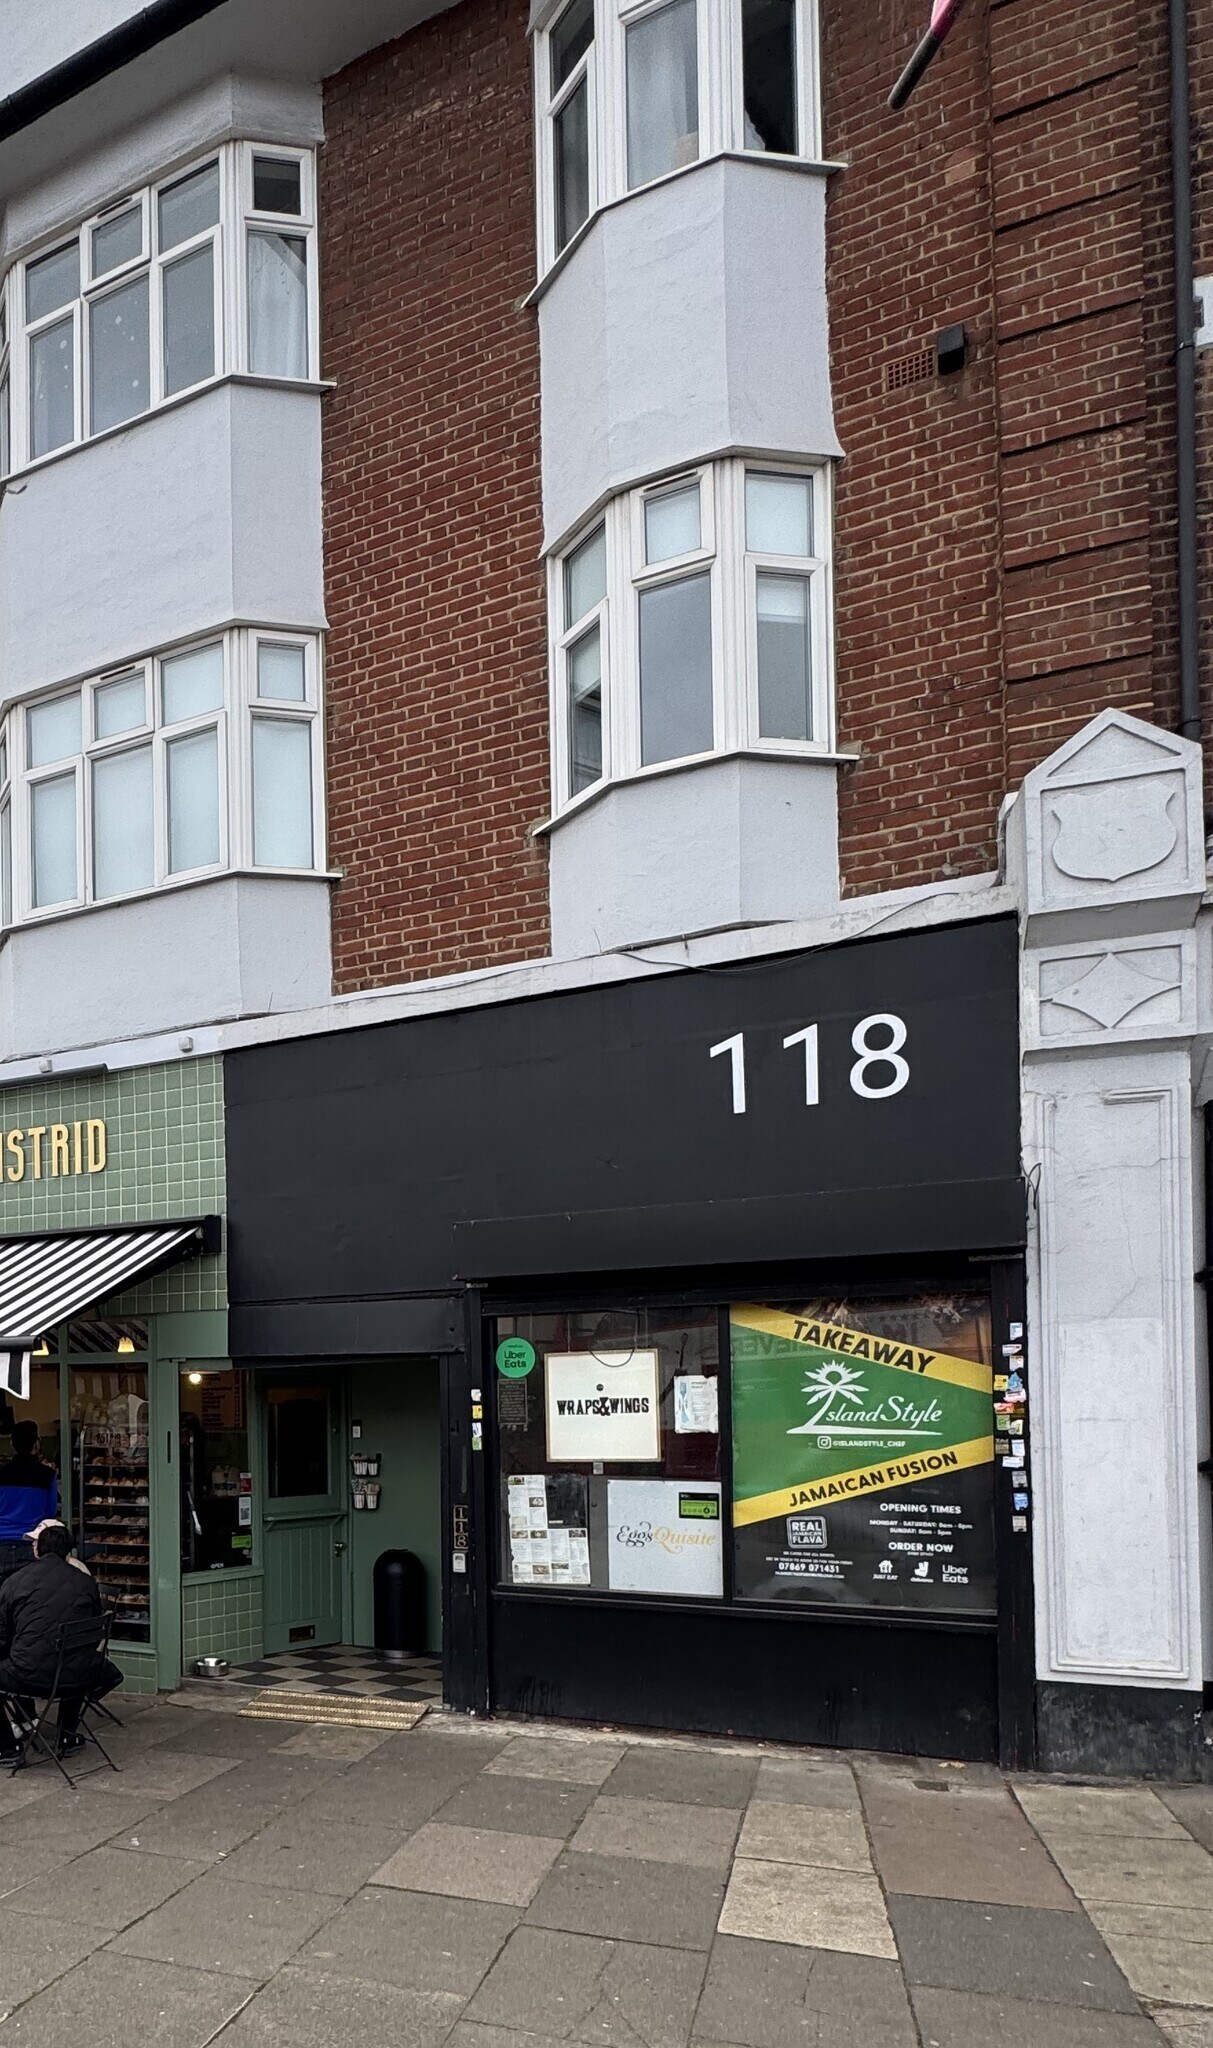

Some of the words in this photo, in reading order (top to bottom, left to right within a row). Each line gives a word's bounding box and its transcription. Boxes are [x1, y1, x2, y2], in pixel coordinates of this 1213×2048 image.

[709, 1013, 910, 1114] 118
[0, 1118, 107, 1183] STRID
[793, 1319, 936, 1374] TAKEAWAY
[504, 1351, 526, 1359] Uber
[504, 1360, 527, 1369] Eats
[789, 1470, 885, 1507] JAMAICAN
[886, 1451, 958, 1482] FUSION
[879, 1503, 927, 1513] OPENING
[930, 1504, 962, 1515] TIMES
[791, 1521, 822, 1532] REAL
[792, 1535, 823, 1544] FLAVA
[888, 1542, 923, 1552] ORDER
[926, 1543, 954, 1553] NOW
[778, 1562, 806, 1572] 07869
[808, 1564, 840, 1573] 071431
[942, 1565, 968, 1575] Uber
[942, 1575, 969, 1584] Eats
